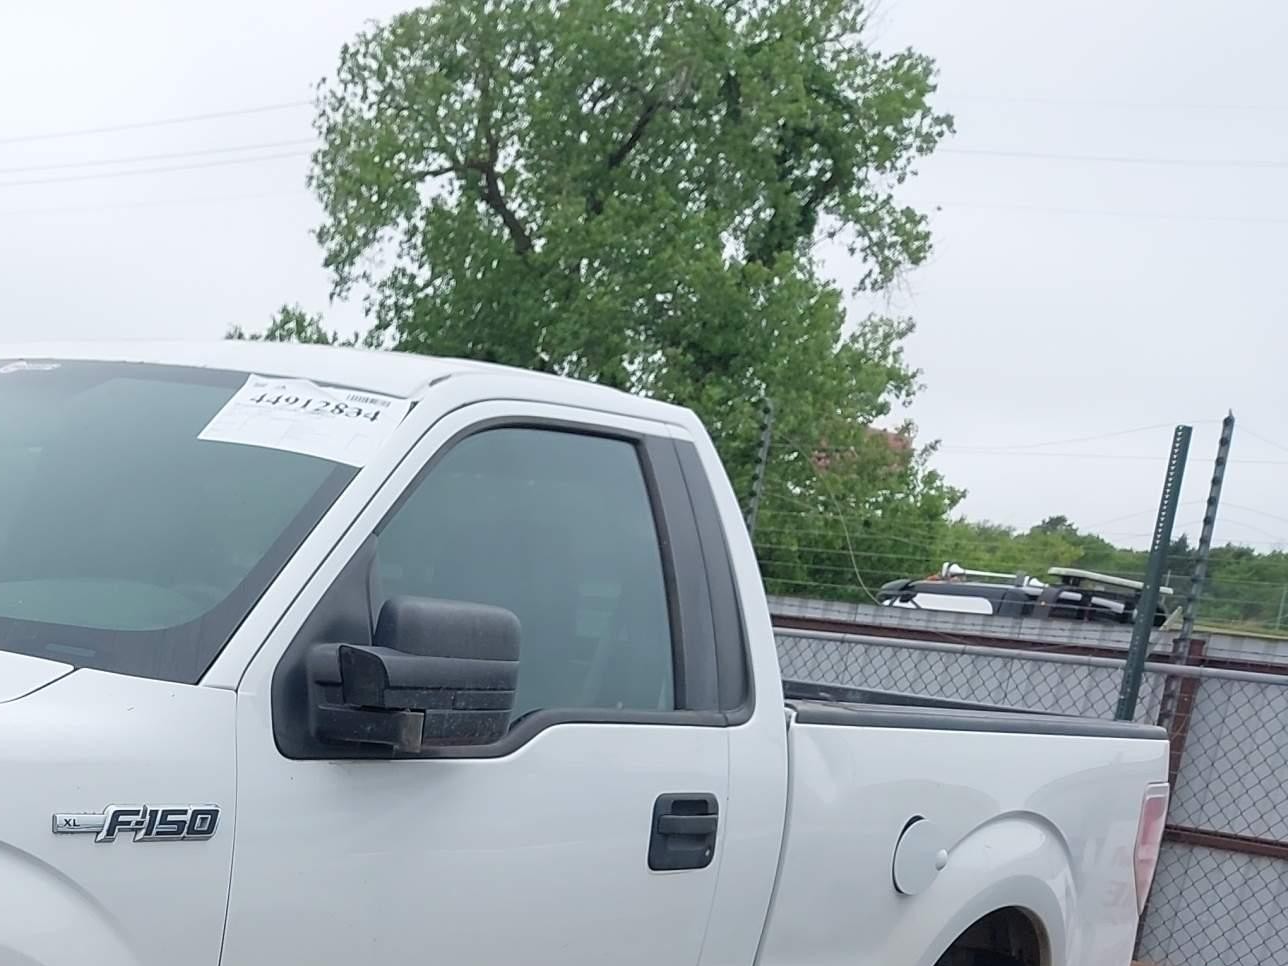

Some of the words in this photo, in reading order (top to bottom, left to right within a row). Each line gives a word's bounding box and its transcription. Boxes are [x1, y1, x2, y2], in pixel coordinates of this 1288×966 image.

[249, 392, 381, 422] 44912834
[63, 818, 81, 828] XL
[95, 804, 222, 842] F-150
